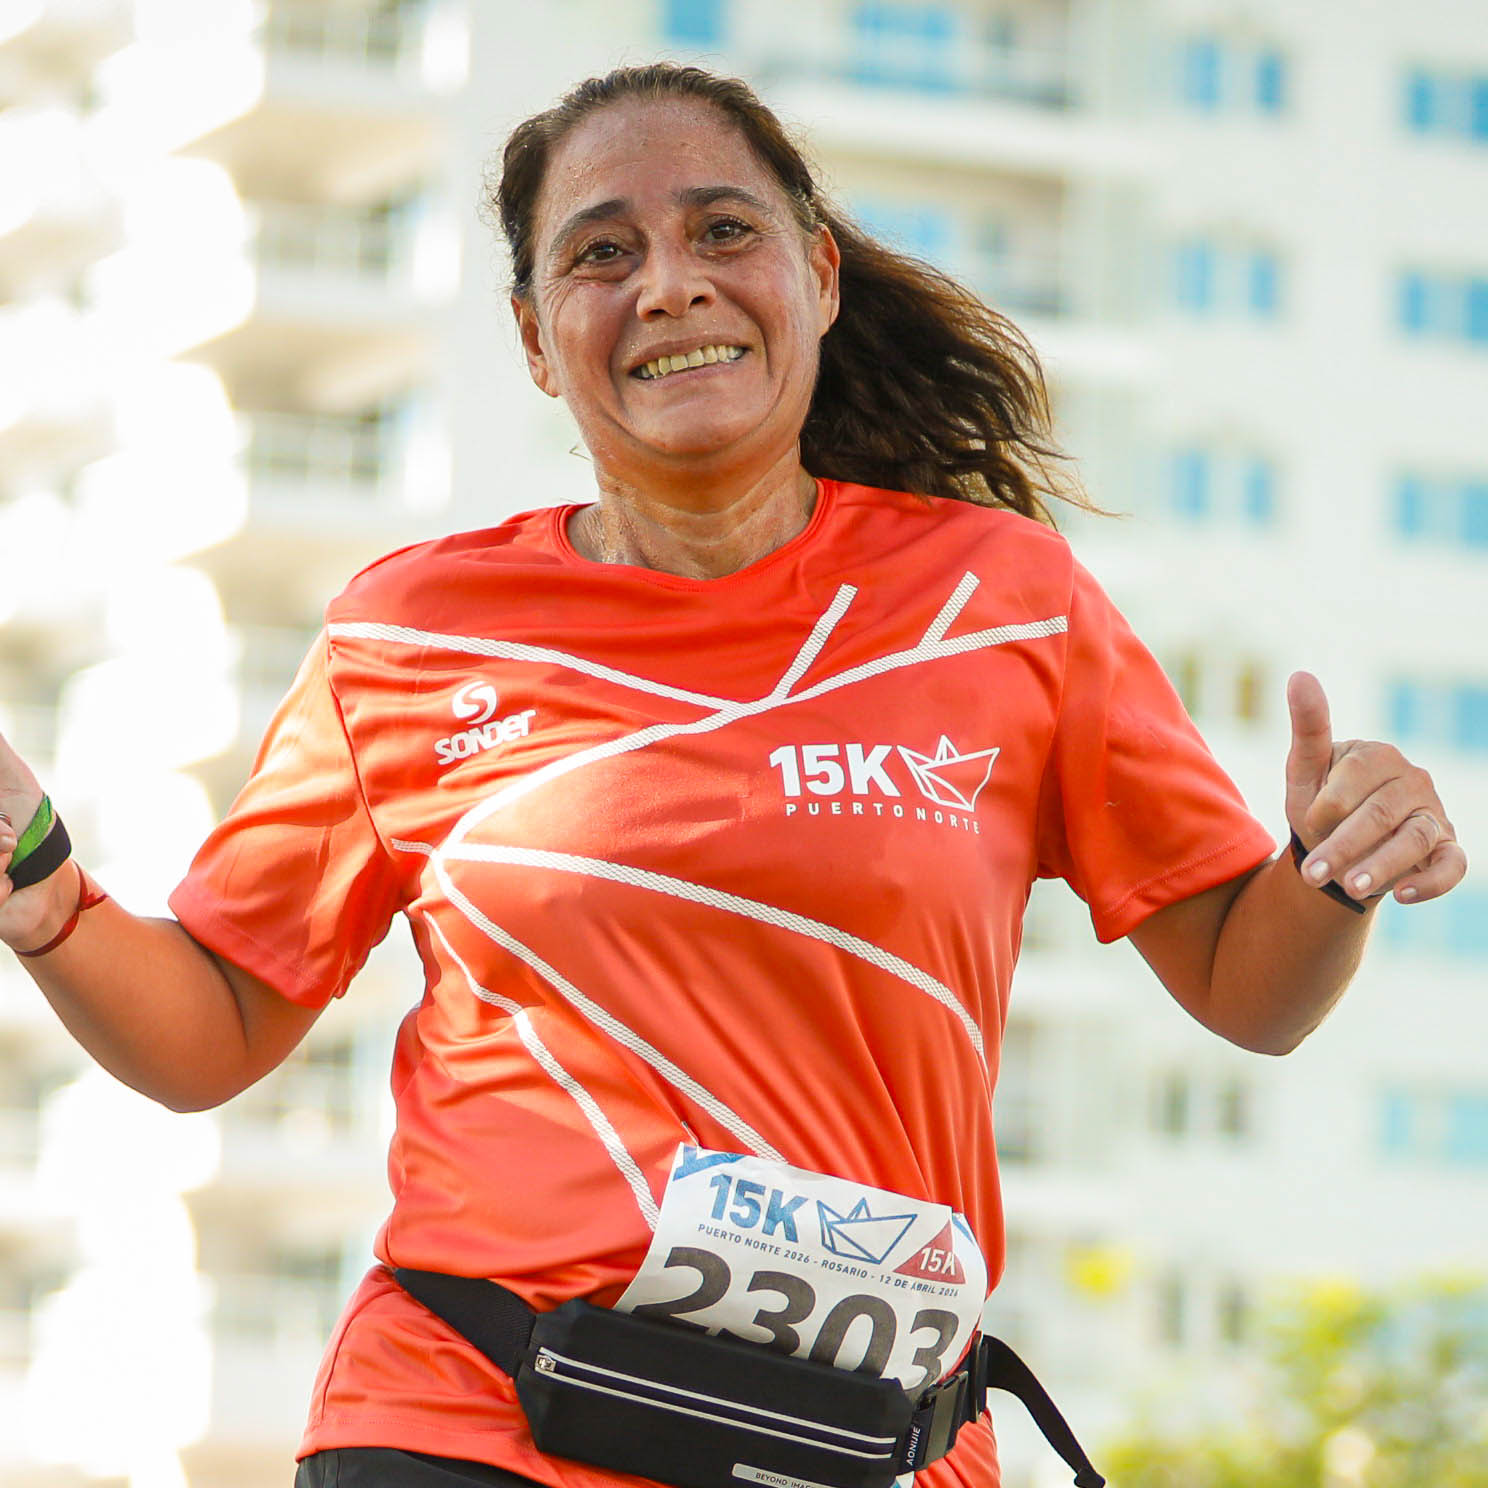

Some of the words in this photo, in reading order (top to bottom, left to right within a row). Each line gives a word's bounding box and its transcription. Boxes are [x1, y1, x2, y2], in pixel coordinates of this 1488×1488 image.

[769, 744, 902, 797] 15K
[785, 802, 904, 817] PUERTO
[916, 807, 980, 834] NORTE
[710, 1173, 809, 1243] 15K
[698, 1223, 742, 1244] PUERTO
[744, 1237, 782, 1256] NORTE
[784, 1249, 810, 1264] 2026
[821, 1259, 868, 1279] ROSARIO
[880, 1274, 891, 1285] 12
[894, 1278, 909, 1289] DE
[911, 1281, 936, 1294] ABRIL
[630, 1246, 960, 1398] 2303
[906, 1426, 921, 1466] AONIJIE
[755, 1472, 787, 1486] BEYOND
